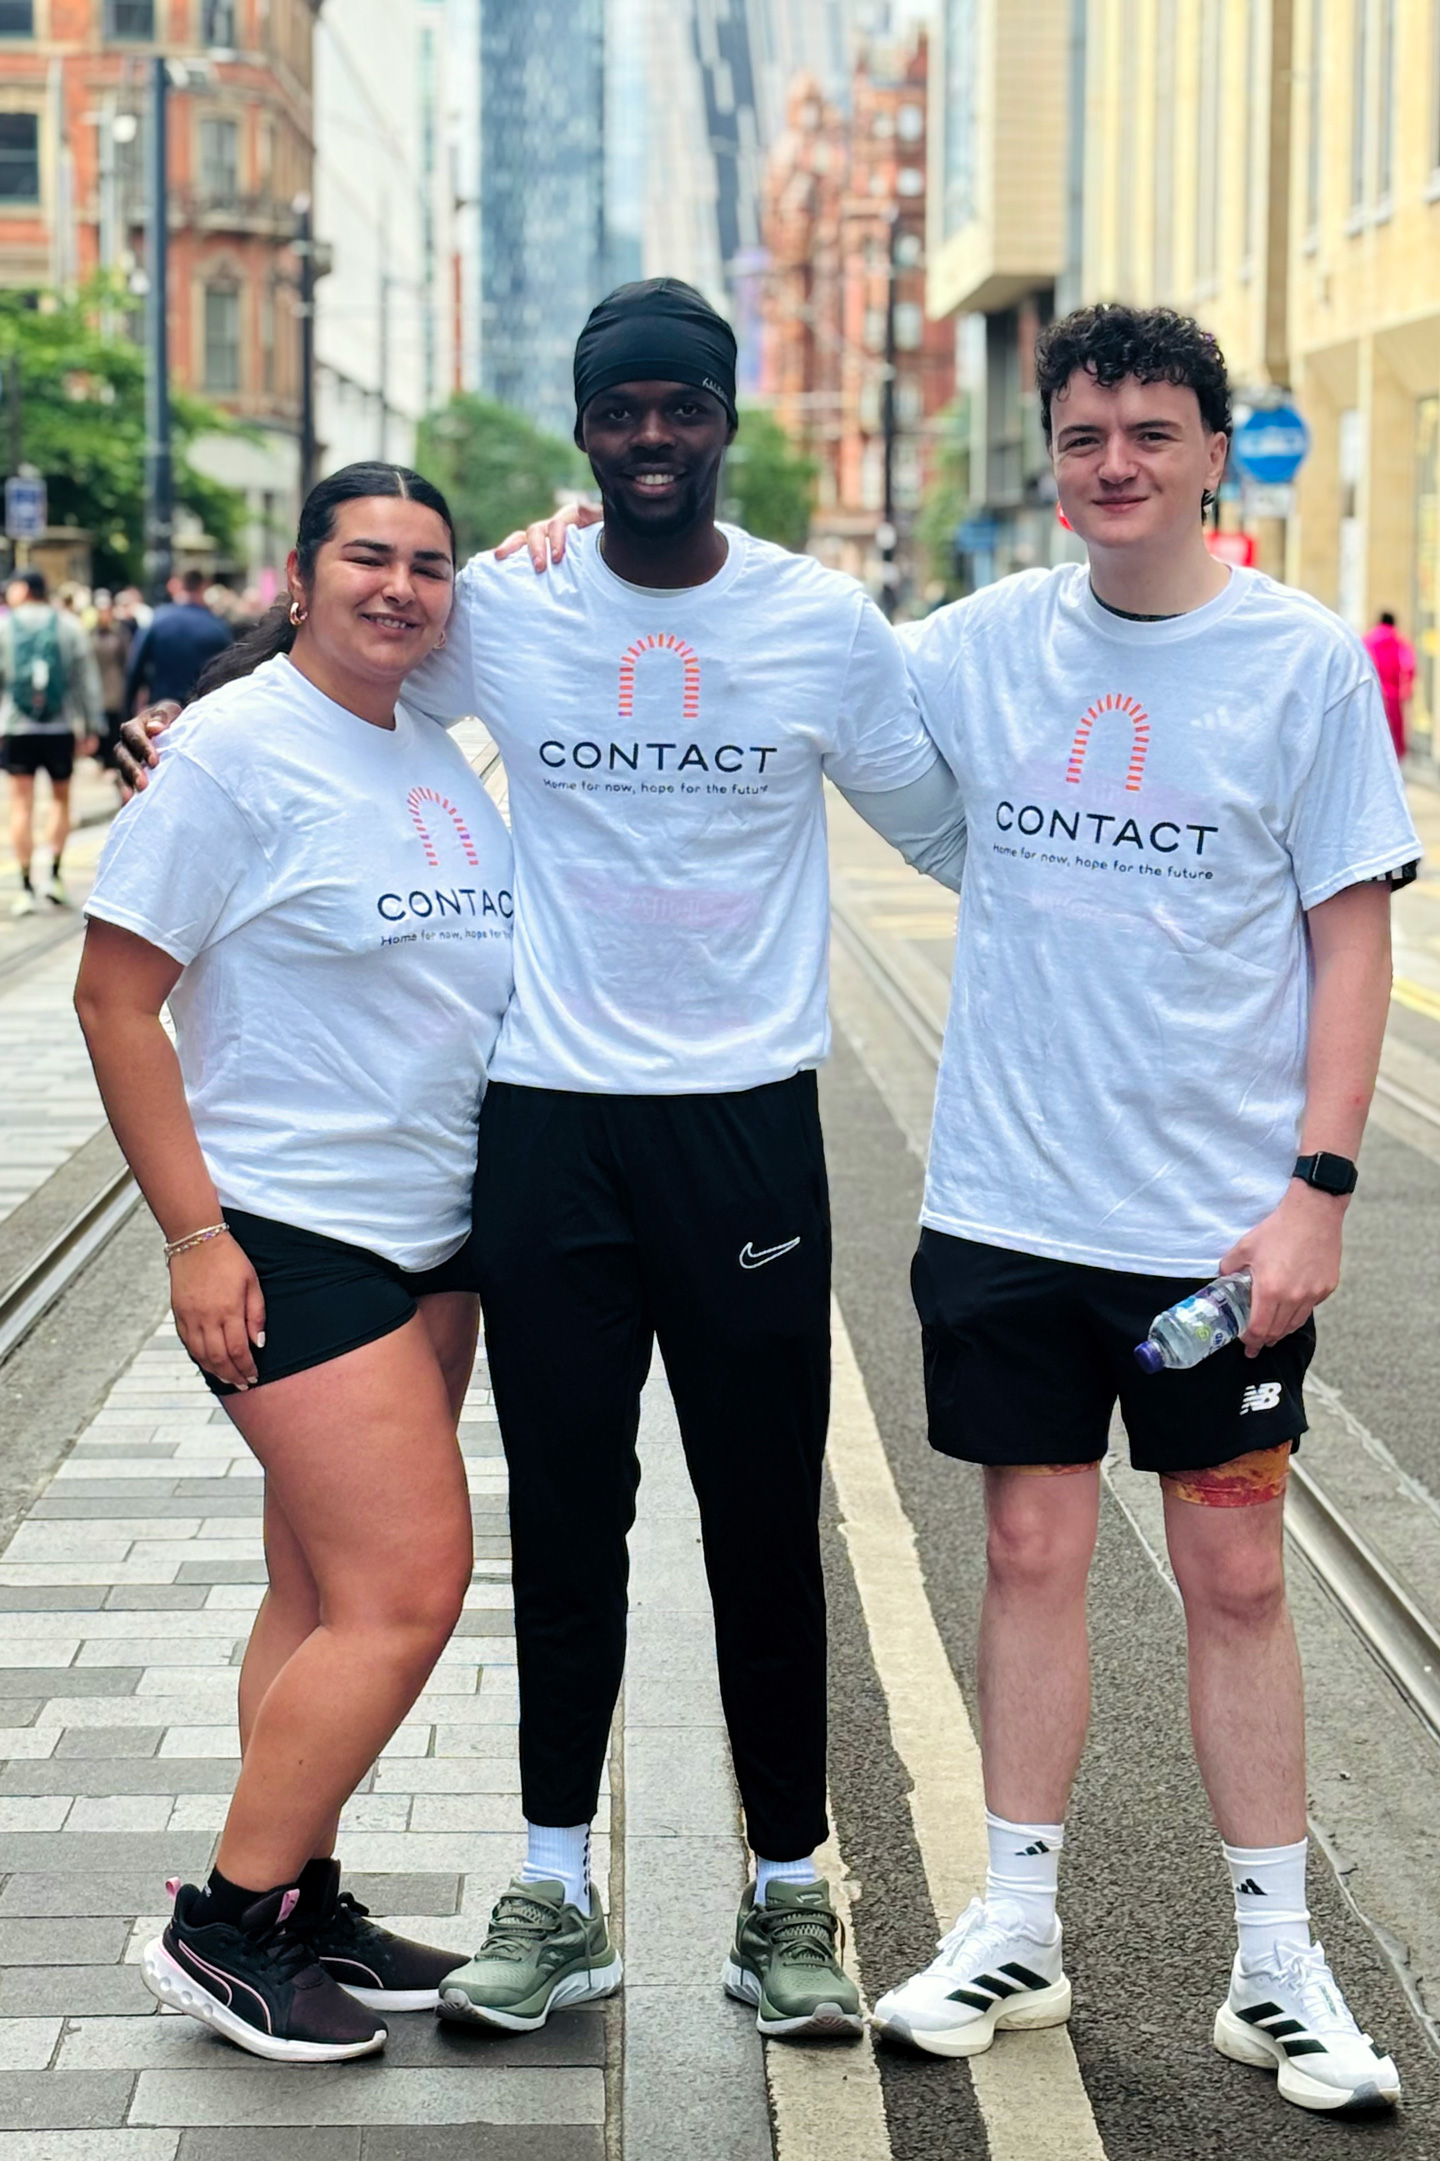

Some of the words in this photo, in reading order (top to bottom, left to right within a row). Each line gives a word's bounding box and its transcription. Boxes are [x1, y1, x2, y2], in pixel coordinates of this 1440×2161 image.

[539, 741, 778, 774] CONTACT
[543, 779, 577, 791] Home
[582, 780, 600, 792] for
[605, 783, 636, 795] now,
[641, 782, 675, 795] hope
[681, 783, 701, 794] for
[707, 784, 727, 794] the
[996, 801, 1219, 856] CONTACT
[993, 843, 1017, 857] Home
[1021, 847, 1036, 860] for
[1041, 854, 1071, 868] now,
[1075, 855, 1108, 870] hope
[1113, 859, 1134, 874] for
[1139, 864, 1162, 876] the
[1168, 866, 1214, 880] future
[381, 933, 418, 947] Home
[421, 929, 436, 940] for
[439, 931, 463, 941] now,
[464, 927, 488, 940] hope
